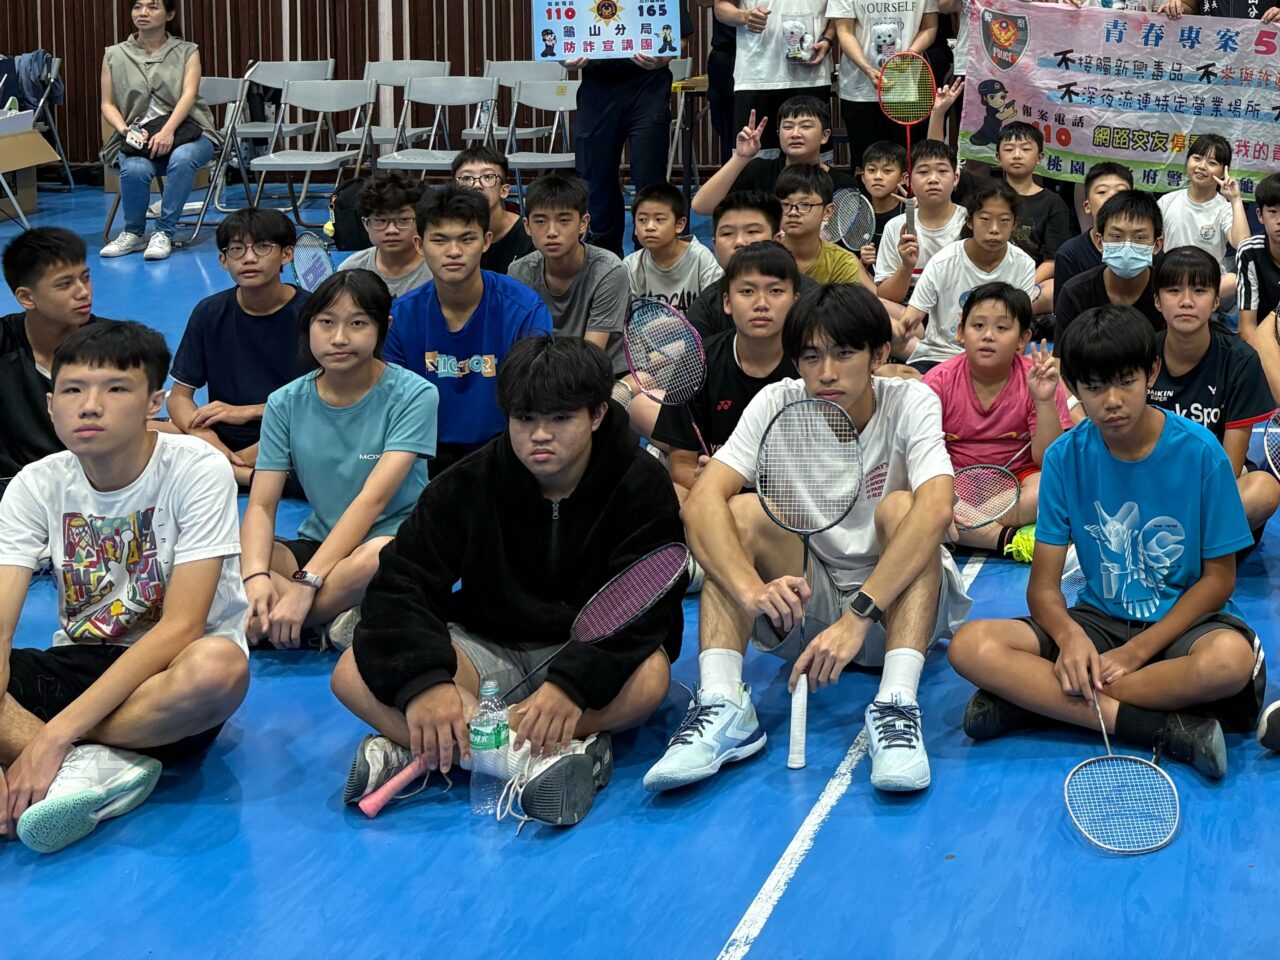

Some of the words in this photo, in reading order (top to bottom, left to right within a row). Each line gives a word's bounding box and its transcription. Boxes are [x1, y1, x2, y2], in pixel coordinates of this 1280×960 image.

[546, 7, 576, 20] 110
[638, 4, 667, 16] 165
[861, 1, 917, 14] YOURSELF
[563, 23, 652, 38] 龜山分局
[563, 38, 653, 53] 防詐宣講團
